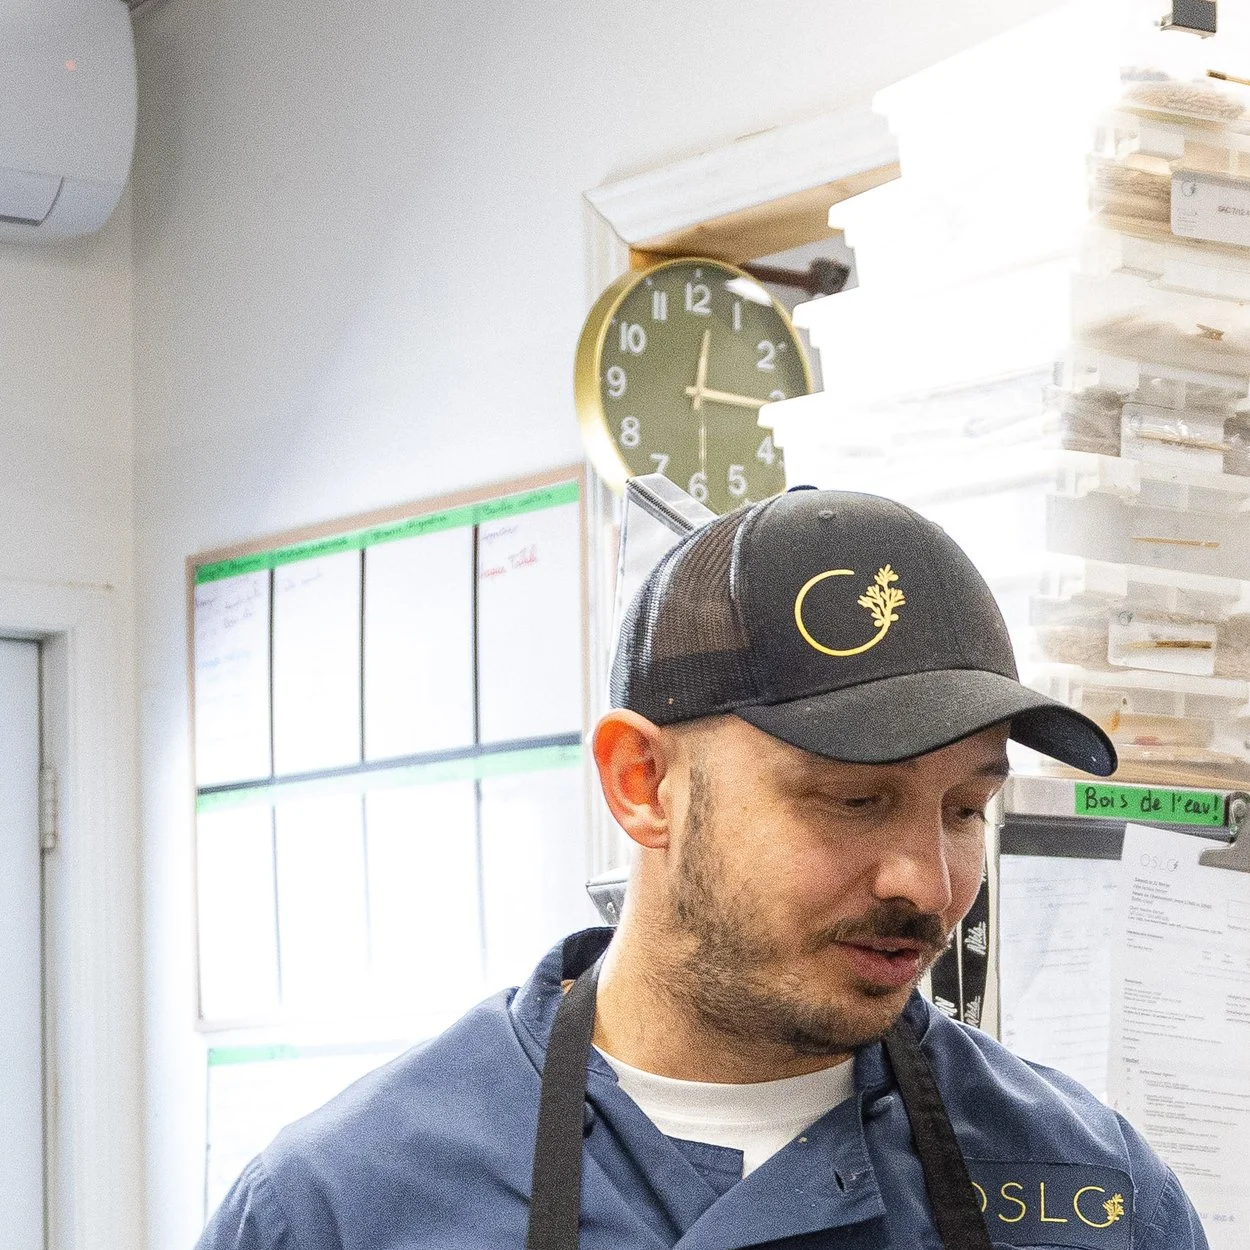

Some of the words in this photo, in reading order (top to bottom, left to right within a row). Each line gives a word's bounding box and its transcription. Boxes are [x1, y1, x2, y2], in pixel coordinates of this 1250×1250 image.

[652, 290, 669, 321] 11
[684, 282, 712, 315] 12
[732, 303, 742, 331] 1
[620, 321, 647, 354] 10
[756, 340, 776, 370] 2
[606, 366, 627, 397] 9
[619, 416, 641, 448] 8
[649, 453, 670, 475] 7
[756, 436, 775, 465] 4
[688, 471, 709, 501] 6
[727, 464, 747, 496] 5
[1084, 786, 1129, 811] Bois
[1140, 789, 1162, 813] de
[1170, 793, 1221, 822] l'eau!
